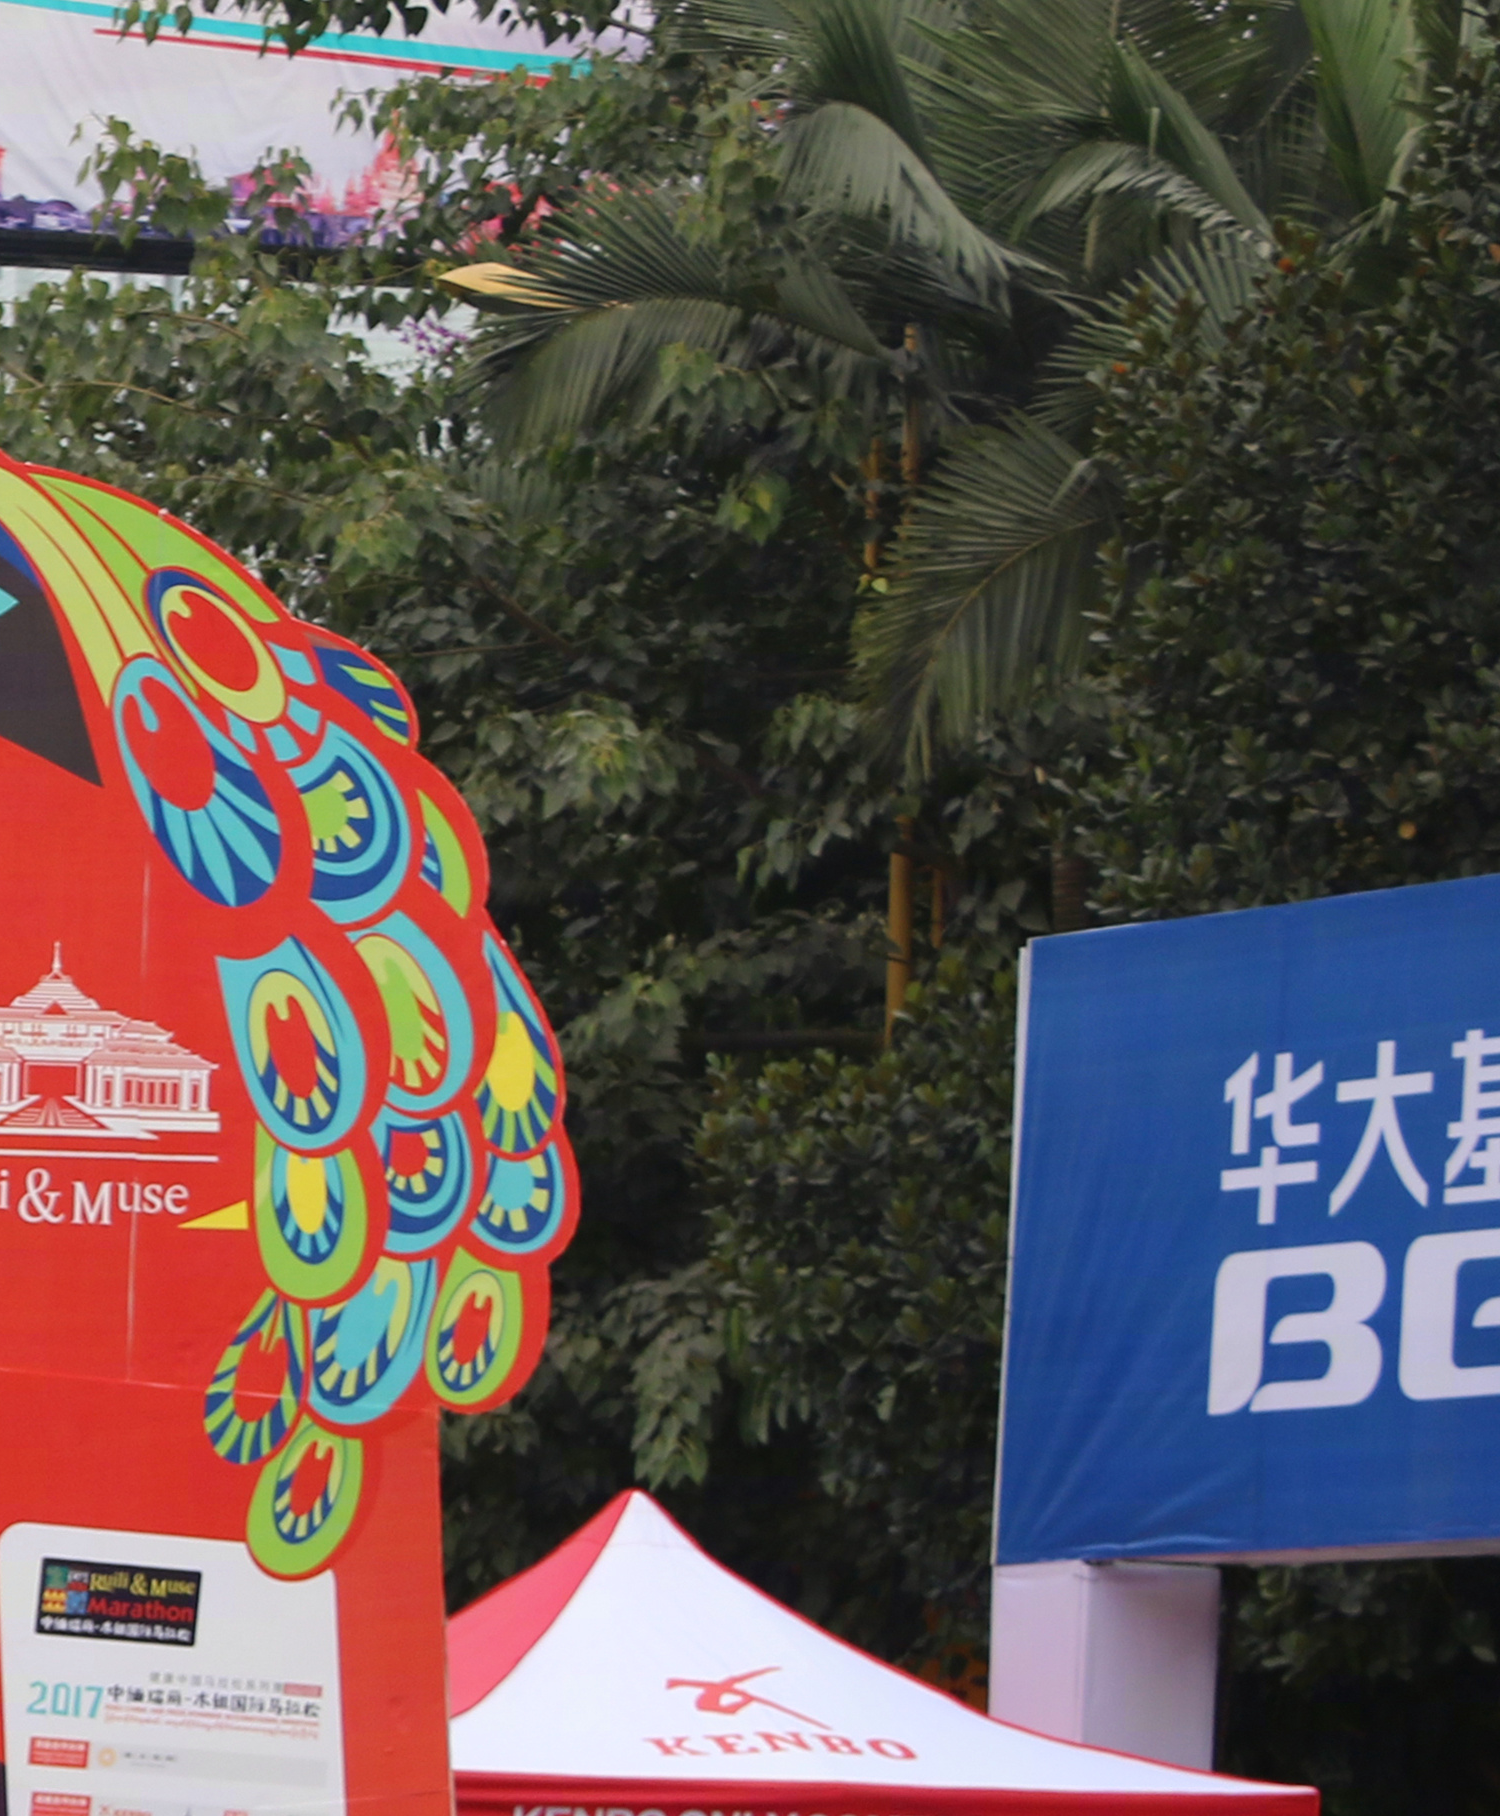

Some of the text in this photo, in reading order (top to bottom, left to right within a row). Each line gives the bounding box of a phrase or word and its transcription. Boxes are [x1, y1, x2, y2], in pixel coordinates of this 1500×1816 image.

[16, 1167, 67, 1225] &
[70, 1180, 190, 1226] Muse
[89, 1566, 196, 1598] Ruili & Muse
[86, 1596, 195, 1623] Marathon
[26, 1681, 105, 1719] 2017
[642, 1731, 919, 1763] KENBO
